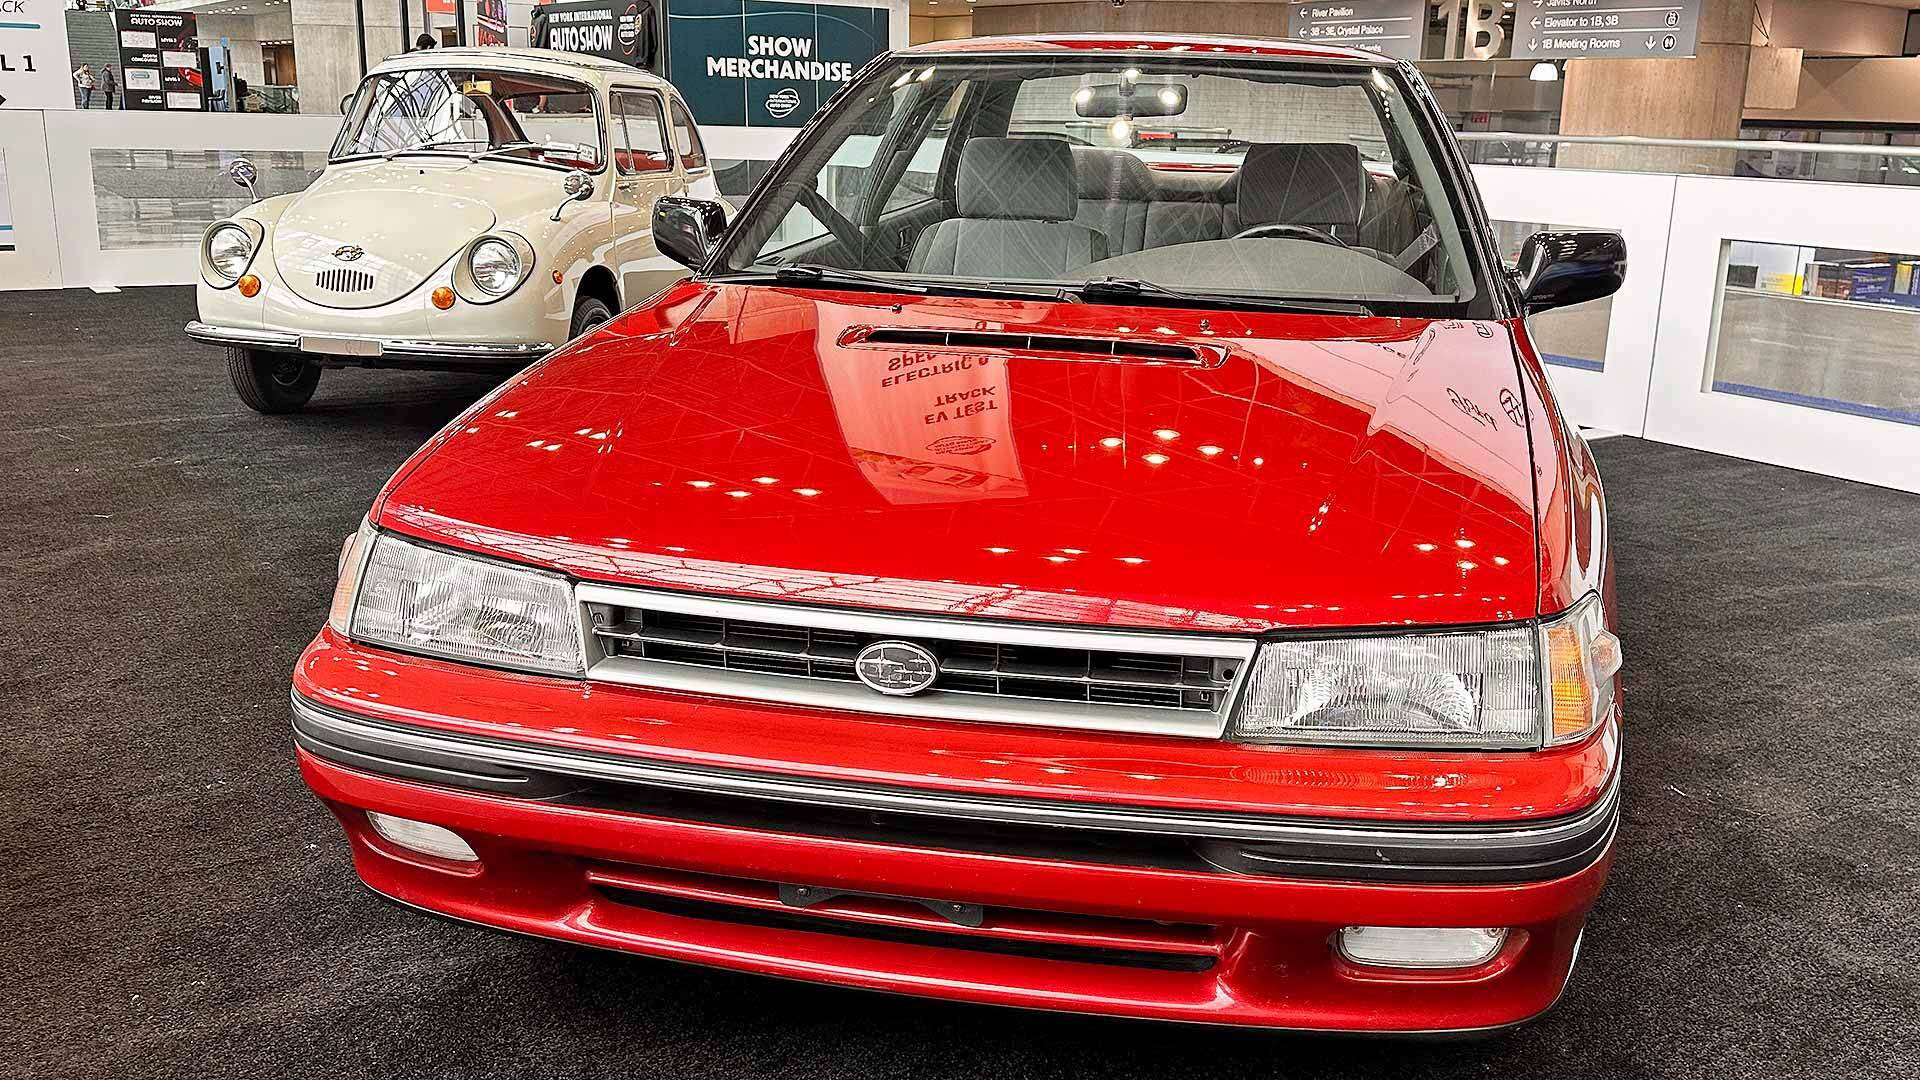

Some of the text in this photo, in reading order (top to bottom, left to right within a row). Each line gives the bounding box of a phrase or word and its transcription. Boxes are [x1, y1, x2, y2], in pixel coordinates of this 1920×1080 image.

[0, 0, 24, 13] CK
[1312, 7, 1354, 17] River Pavilion
[130, 17, 183, 27] AUTO SHOW
[1544, 16, 1579, 28] Elevator
[1580, 16, 1589, 27] to
[1337, 25, 1360, 37] Crystal
[1360, 24, 1384, 35] Palace
[1438, 0, 1505, 60] 1B
[550, 26, 580, 52] AUTO
[580, 24, 613, 52] SHOW
[1542, 37, 1621, 51] 1B Meeting Rooms
[747, 35, 812, 58] SHOW
[23, 54, 36, 72] 1
[706, 56, 853, 82] MERCHANDISE
